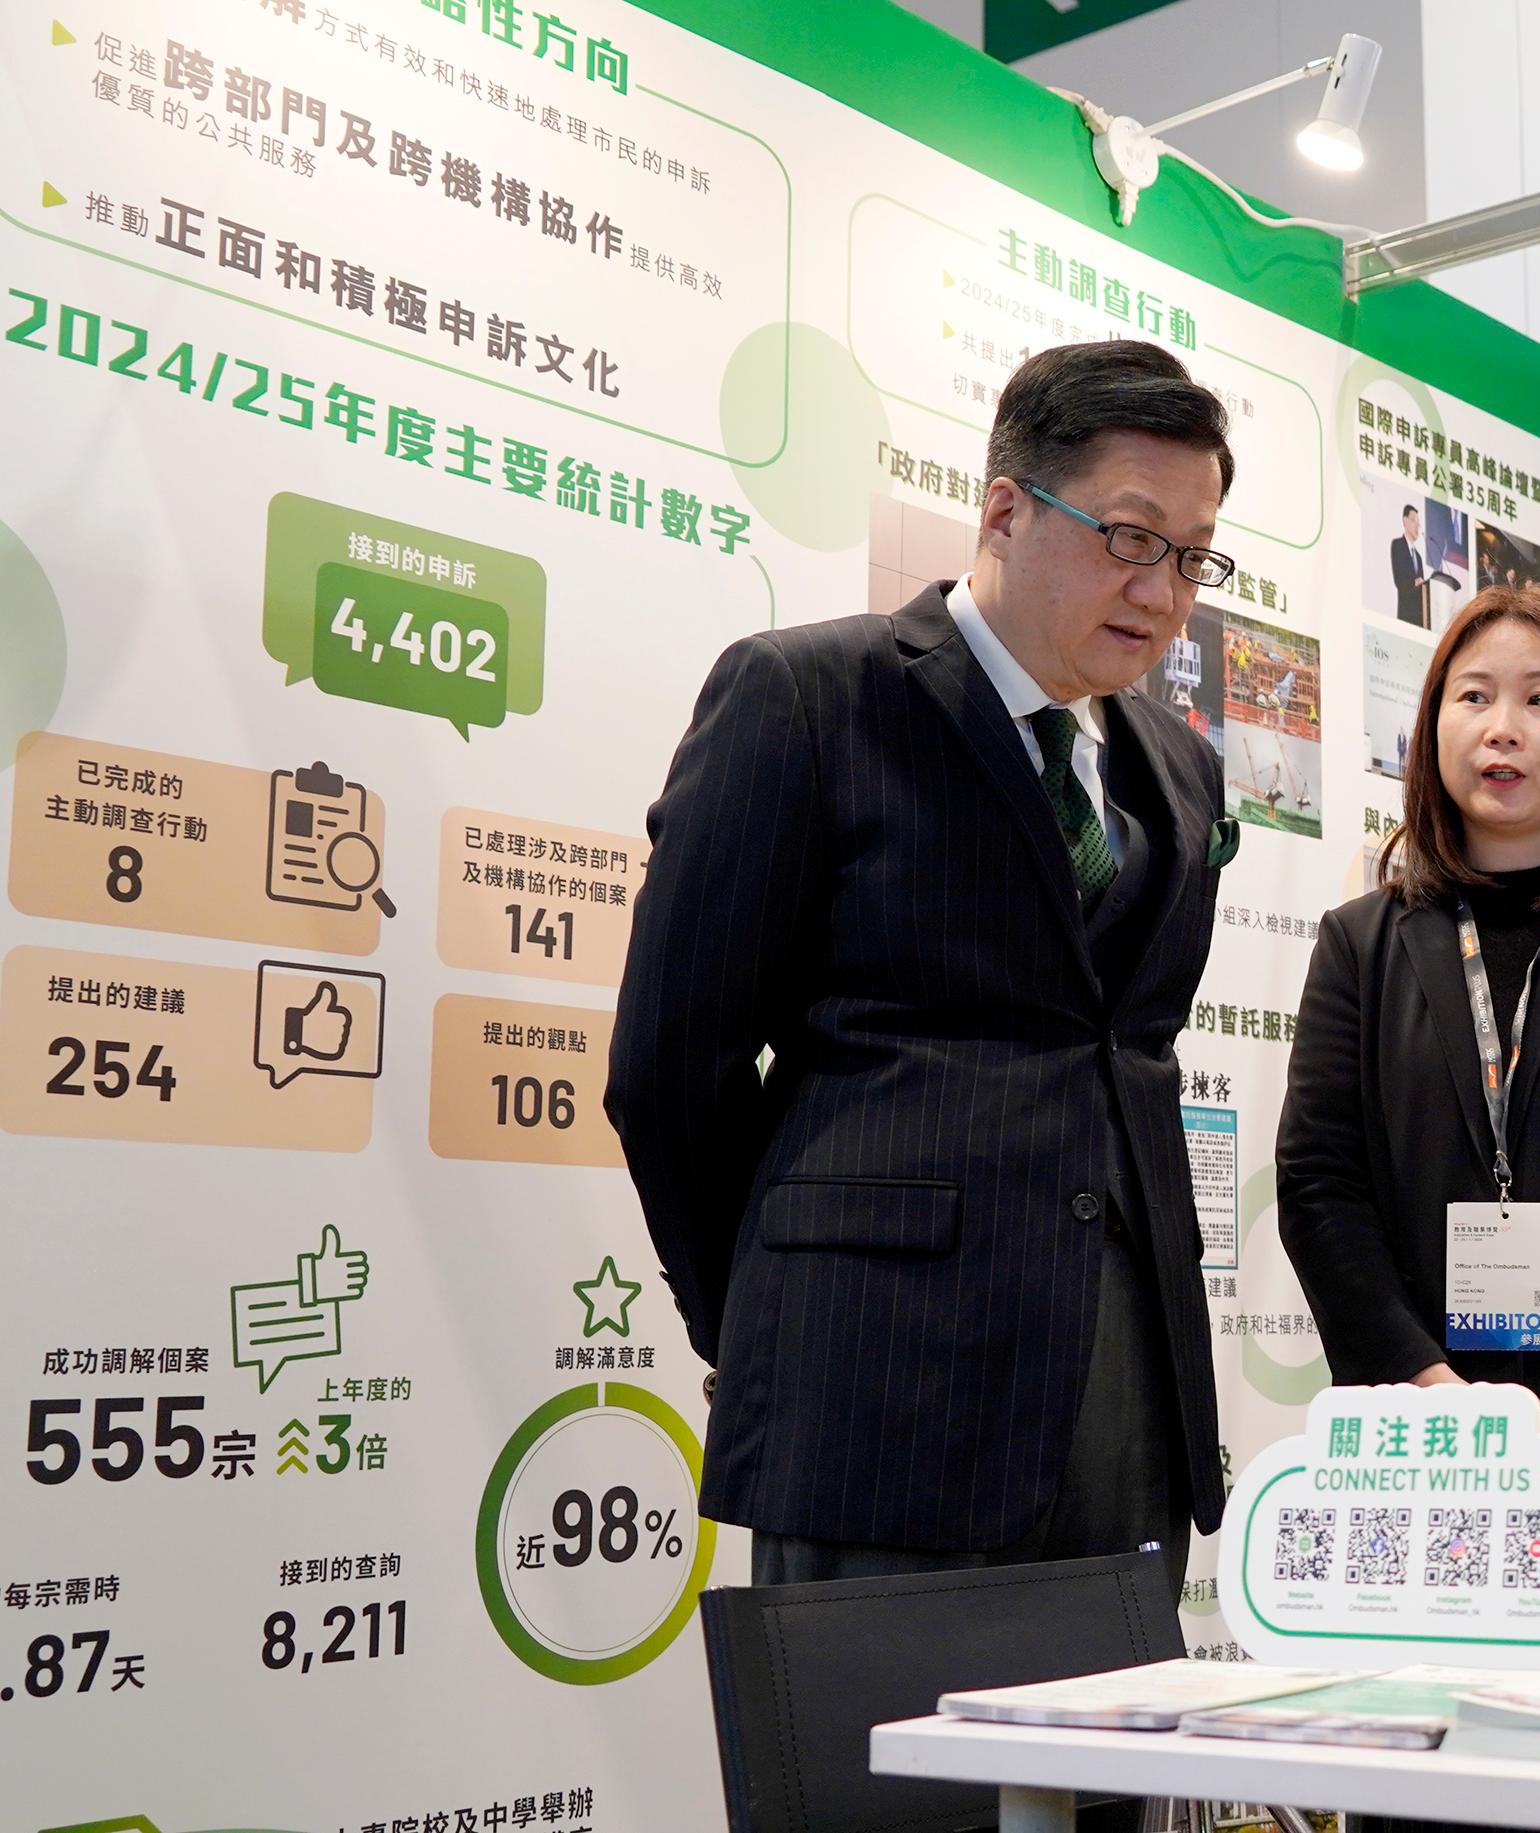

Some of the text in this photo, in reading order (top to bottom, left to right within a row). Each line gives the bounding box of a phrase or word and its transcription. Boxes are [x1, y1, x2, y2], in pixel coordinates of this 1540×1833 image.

[92, 70, 318, 179] 優質的公共服務
[84, 190, 621, 398] 推動正面和積極申訴文化
[998, 228, 1196, 351] 主動調查行動
[5, 287, 751, 556] 2024/25年度主要統計數字
[1359, 432, 1518, 522] 申訴專員公署35周年
[347, 531, 477, 590] 接到的申訴
[330, 597, 497, 684] 4,402
[77, 759, 183, 800] 已完成的
[45, 794, 208, 842] 主動調查行動
[106, 846, 143, 902] 8
[464, 826, 628, 873] 已處理涉及跨部門
[462, 860, 627, 907] 及機構協作的個案
[505, 904, 574, 961] 141
[48, 975, 185, 1014] 提出的建議
[483, 1020, 587, 1054] 提出的觀點
[46, 1036, 176, 1102] 254
[491, 1074, 576, 1129] 106
[43, 1346, 209, 1376] 成功調解個案
[555, 1346, 655, 1369] 調解滿意度
[317, 1376, 412, 1404] 上年度的
[26, 1396, 257, 1485] 555宗
[316, 1414, 388, 1475] 3倍
[1328, 1415, 1508, 1458] 關注我們
[1314, 1468, 1531, 1492] CONNECT WITH US
[516, 1485, 683, 1570] 近98%
[4, 1574, 120, 1610] 每宗需時
[280, 1552, 401, 1586] 接到的查詢
[262, 1600, 407, 1674] 8,211
